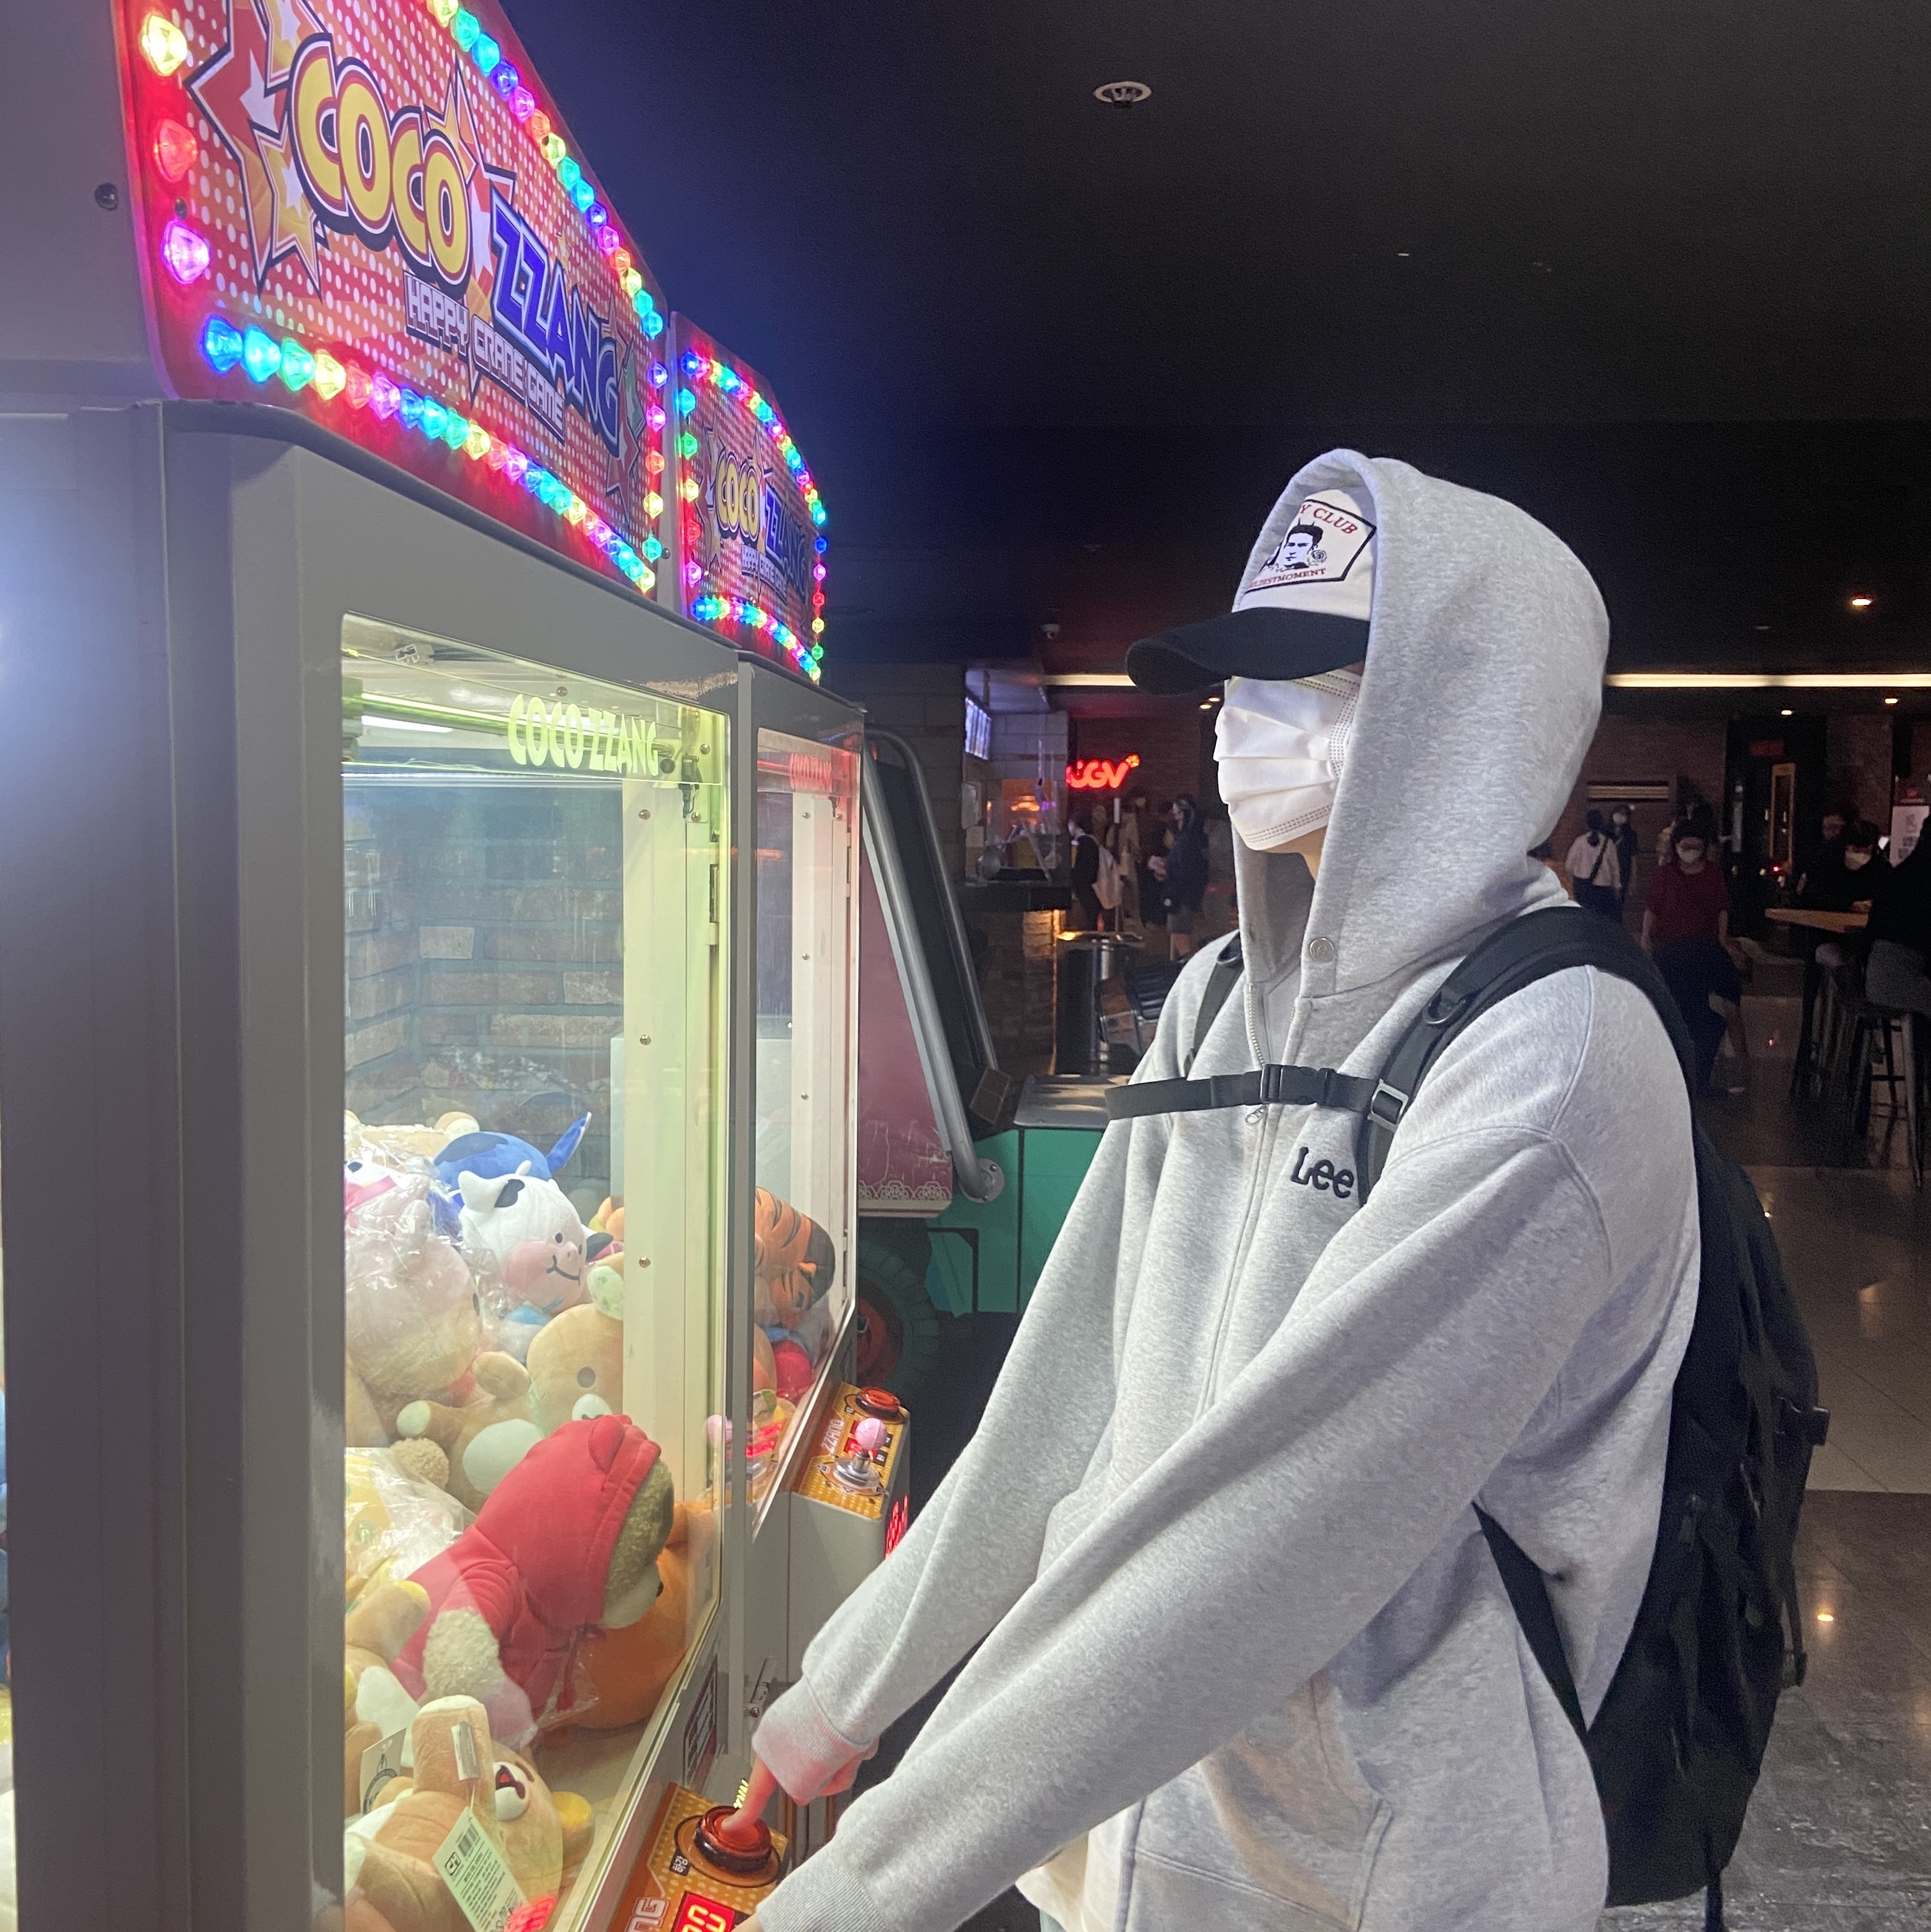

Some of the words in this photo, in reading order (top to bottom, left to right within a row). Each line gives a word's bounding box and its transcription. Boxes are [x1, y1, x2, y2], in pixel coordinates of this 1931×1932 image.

[291, 33, 471, 287] COCO
[490, 188, 621, 455] ZZANG
[404, 272, 469, 356] HAPPY
[473, 315, 526, 402] CRANE
[527, 360, 566, 441] GAME
[716, 451, 760, 543] COCO
[1313, 508, 1358, 534] CLUB
[508, 694, 584, 768] COCO
[589, 707, 658, 776] ZZANG
[1291, 1146, 1354, 1199] Lee
[821, 1419, 845, 1455] ZZANG
[681, 1904, 726, 1932] 0
